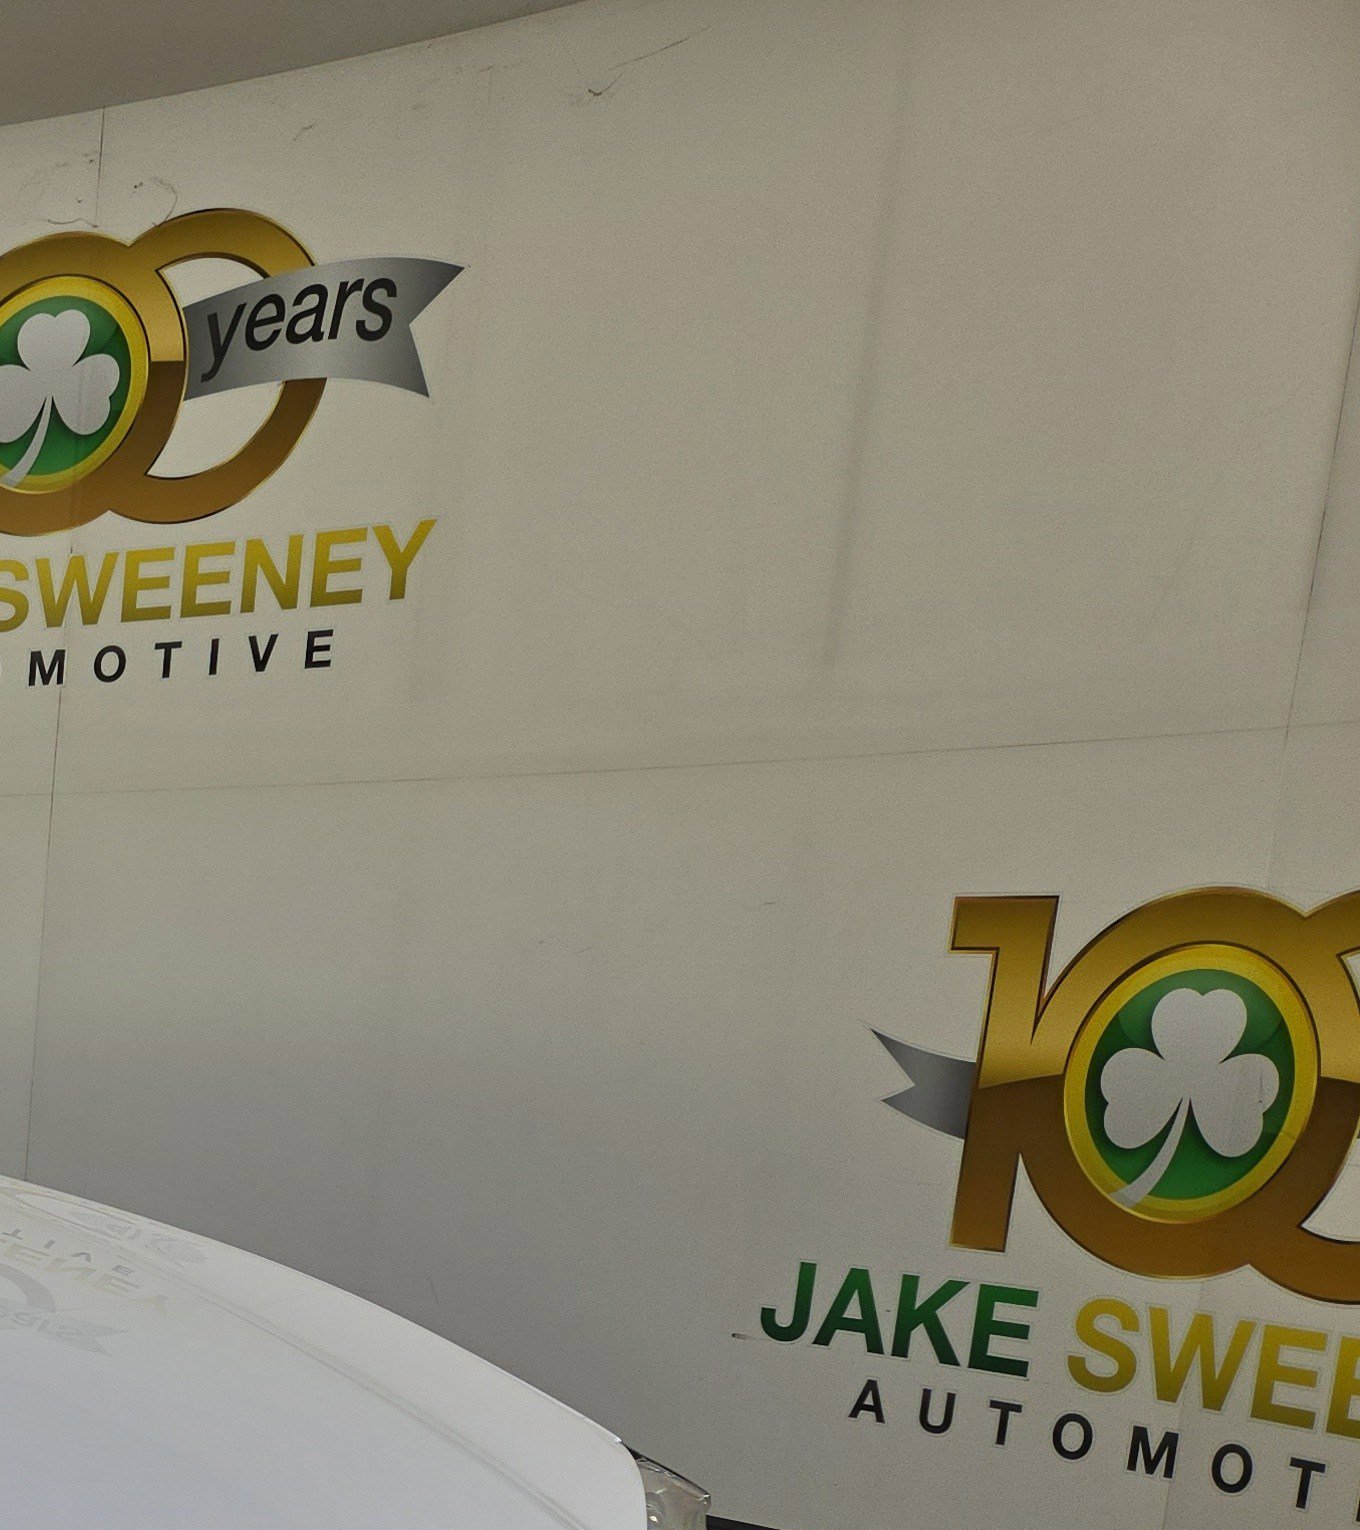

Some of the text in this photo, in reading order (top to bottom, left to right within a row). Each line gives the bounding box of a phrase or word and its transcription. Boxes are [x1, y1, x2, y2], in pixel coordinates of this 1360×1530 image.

[200, 275, 396, 382] years
[760, 1261, 1040, 1378] JAKE
[848, 1378, 1360, 1523] AUTOMOT
